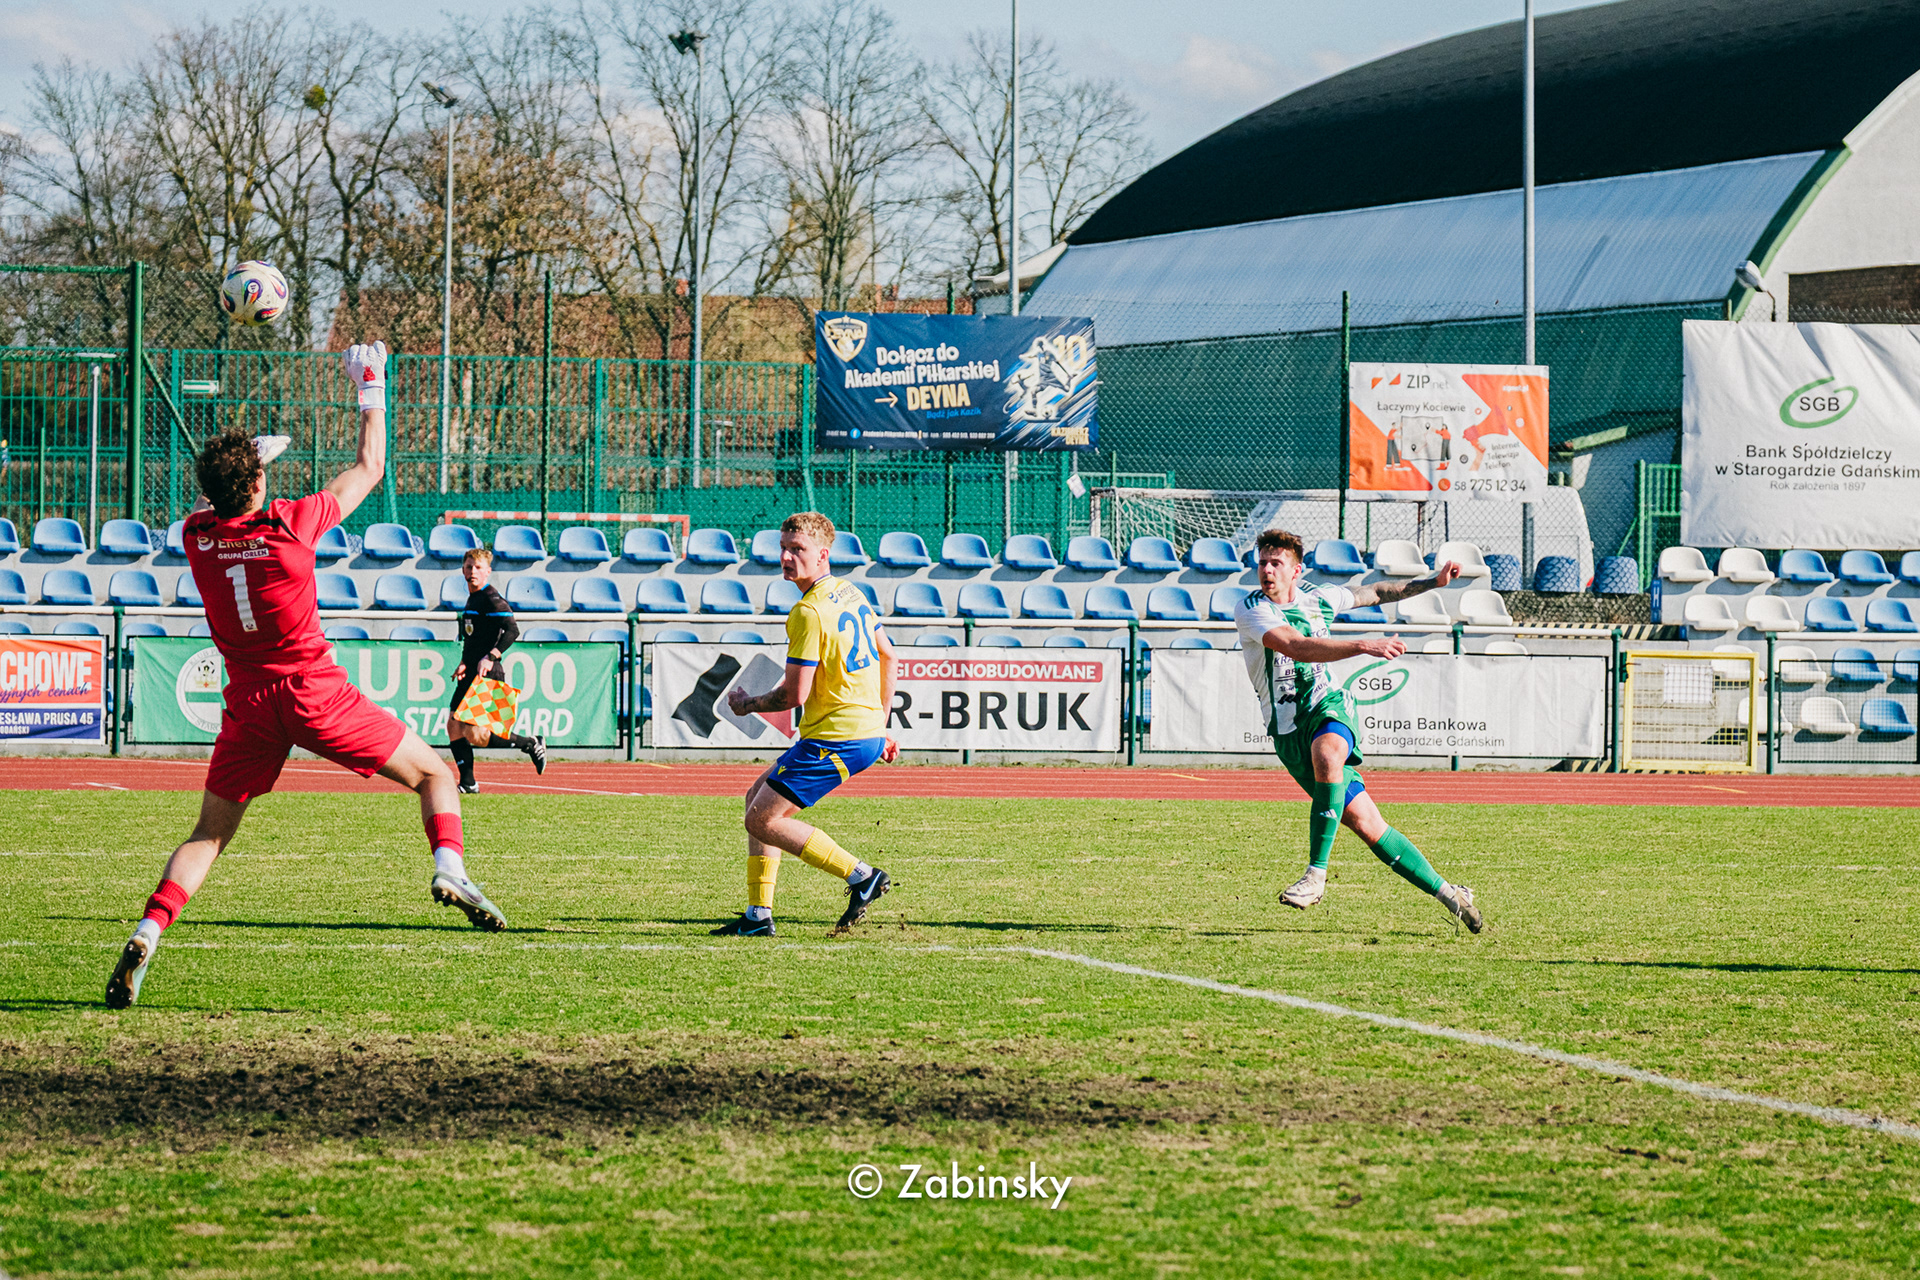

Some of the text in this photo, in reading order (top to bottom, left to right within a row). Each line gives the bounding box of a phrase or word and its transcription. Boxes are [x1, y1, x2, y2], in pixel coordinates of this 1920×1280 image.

[876, 342, 960, 368] Dołącz do
[1053, 335, 1087, 370] 10
[845, 359, 1001, 389] Akademii Piłkarskiej
[1407, 375, 1430, 389] ZIP
[906, 383, 971, 411] DEYNA
[1799, 397, 1840, 412] SGB
[1377, 402, 1466, 414] Łączymy Kociewie
[1491, 441, 1520, 451] Internet
[1486, 451, 1520, 461] Telewizja
[1746, 445, 1892, 463] Bank Spółdzielczy
[1484, 461, 1511, 471] Telefon
[1715, 462, 1920, 480] w Starogardzie Gdańskim
[1454, 479, 1527, 492] 58 775 12 34
[1770, 481, 1866, 491] Rok założenia 1897
[218, 548, 268, 560] GRUPA ORLEN
[225, 563, 258, 633] 1
[0, 650, 92, 692] CHOWE
[912, 661, 1096, 680] OGÓLNOBUDOWLANE
[48, 682, 89, 697] cenach
[1358, 678, 1393, 692] SGB
[43, 712, 78, 726] PRUSA
[79, 712, 94, 725] 45
[404, 706, 574, 737] STAARD
[1364, 717, 1487, 732] Grupa Bankowa
[1244, 732, 1274, 744] Bank
[1367, 734, 1443, 748] Starogardzie
[1446, 735, 1505, 748] Gdańskim
